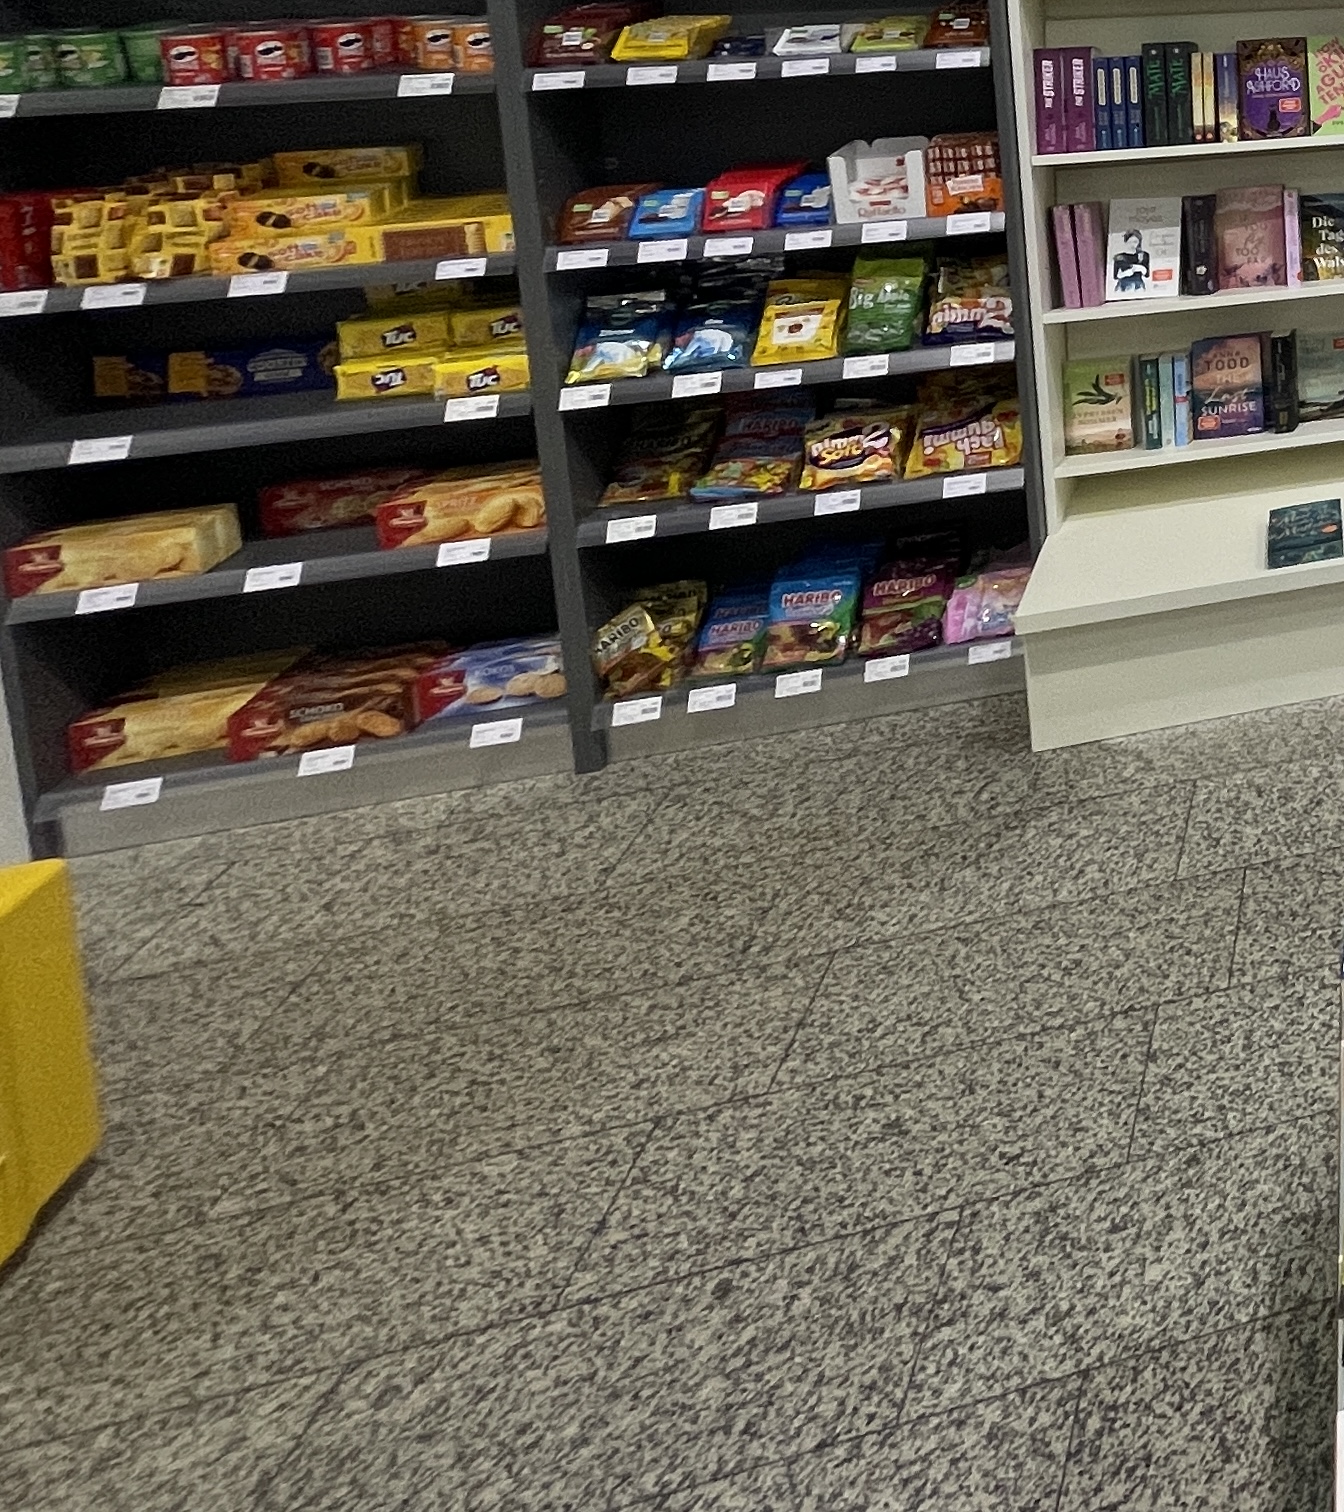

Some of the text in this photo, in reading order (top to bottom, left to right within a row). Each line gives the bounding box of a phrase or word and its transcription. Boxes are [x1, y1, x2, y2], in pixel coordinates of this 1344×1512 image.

[1257, 65, 1289, 80] HAUS
[1312, 215, 1334, 229] Die
[1316, 243, 1337, 257] des
[1204, 356, 1250, 371] TODD
[1201, 401, 1257, 416] SUNRISE
[874, 575, 936, 596] HARIBO
[782, 589, 842, 607] HARIBO
